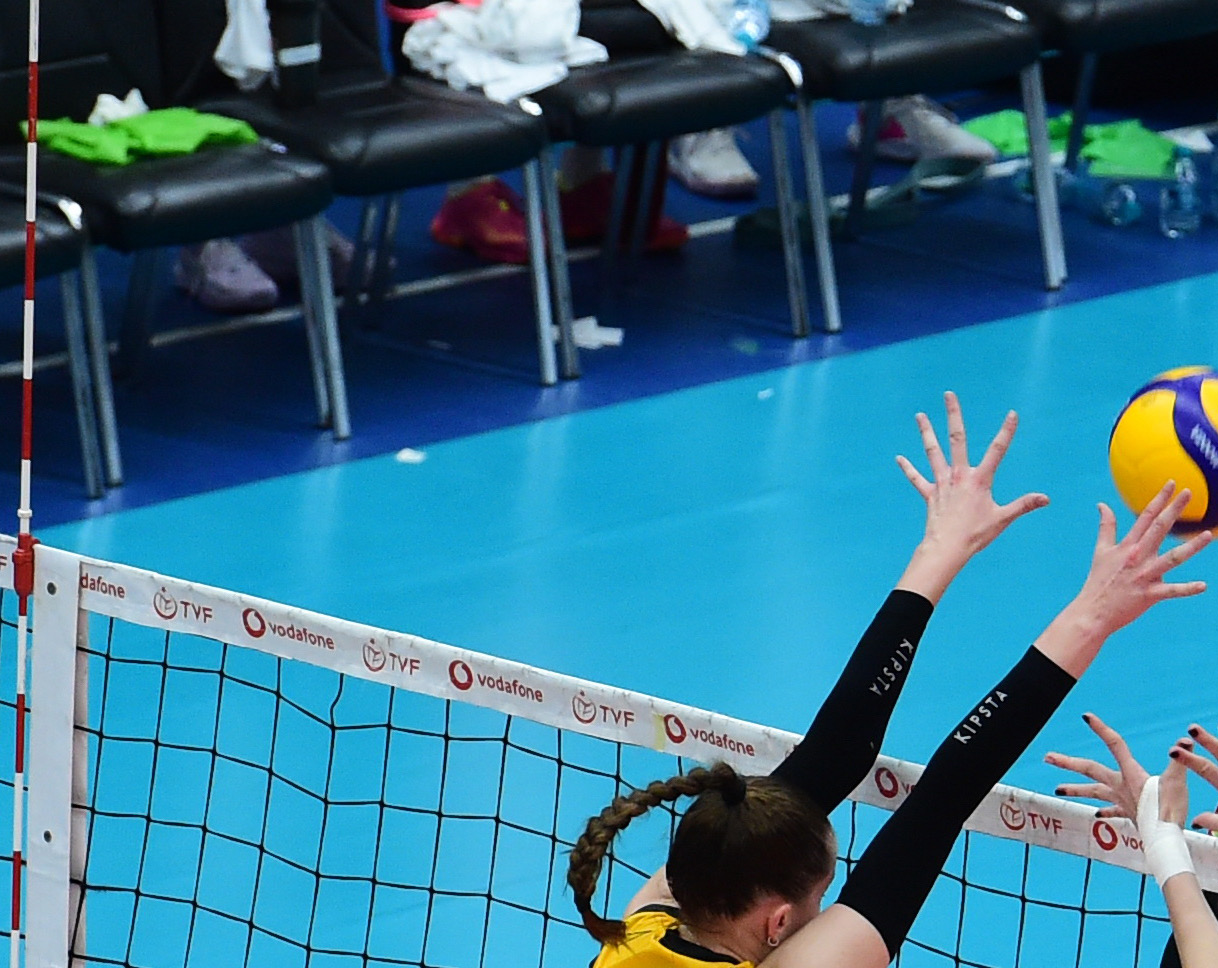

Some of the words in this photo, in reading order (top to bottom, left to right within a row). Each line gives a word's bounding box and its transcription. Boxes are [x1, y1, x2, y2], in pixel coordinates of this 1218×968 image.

[869, 638, 914, 696] KIPSTA
[180, 600, 213, 623] TVF
[268, 621, 334, 650] vodafone
[389, 655, 421, 676] TVF
[477, 673, 544, 703] vodafone
[600, 704, 635, 728] TVF
[689, 727, 756, 757] vodafone
[1027, 812, 1064, 835] TVF
[953, 690, 1008, 744] KIPSTA
